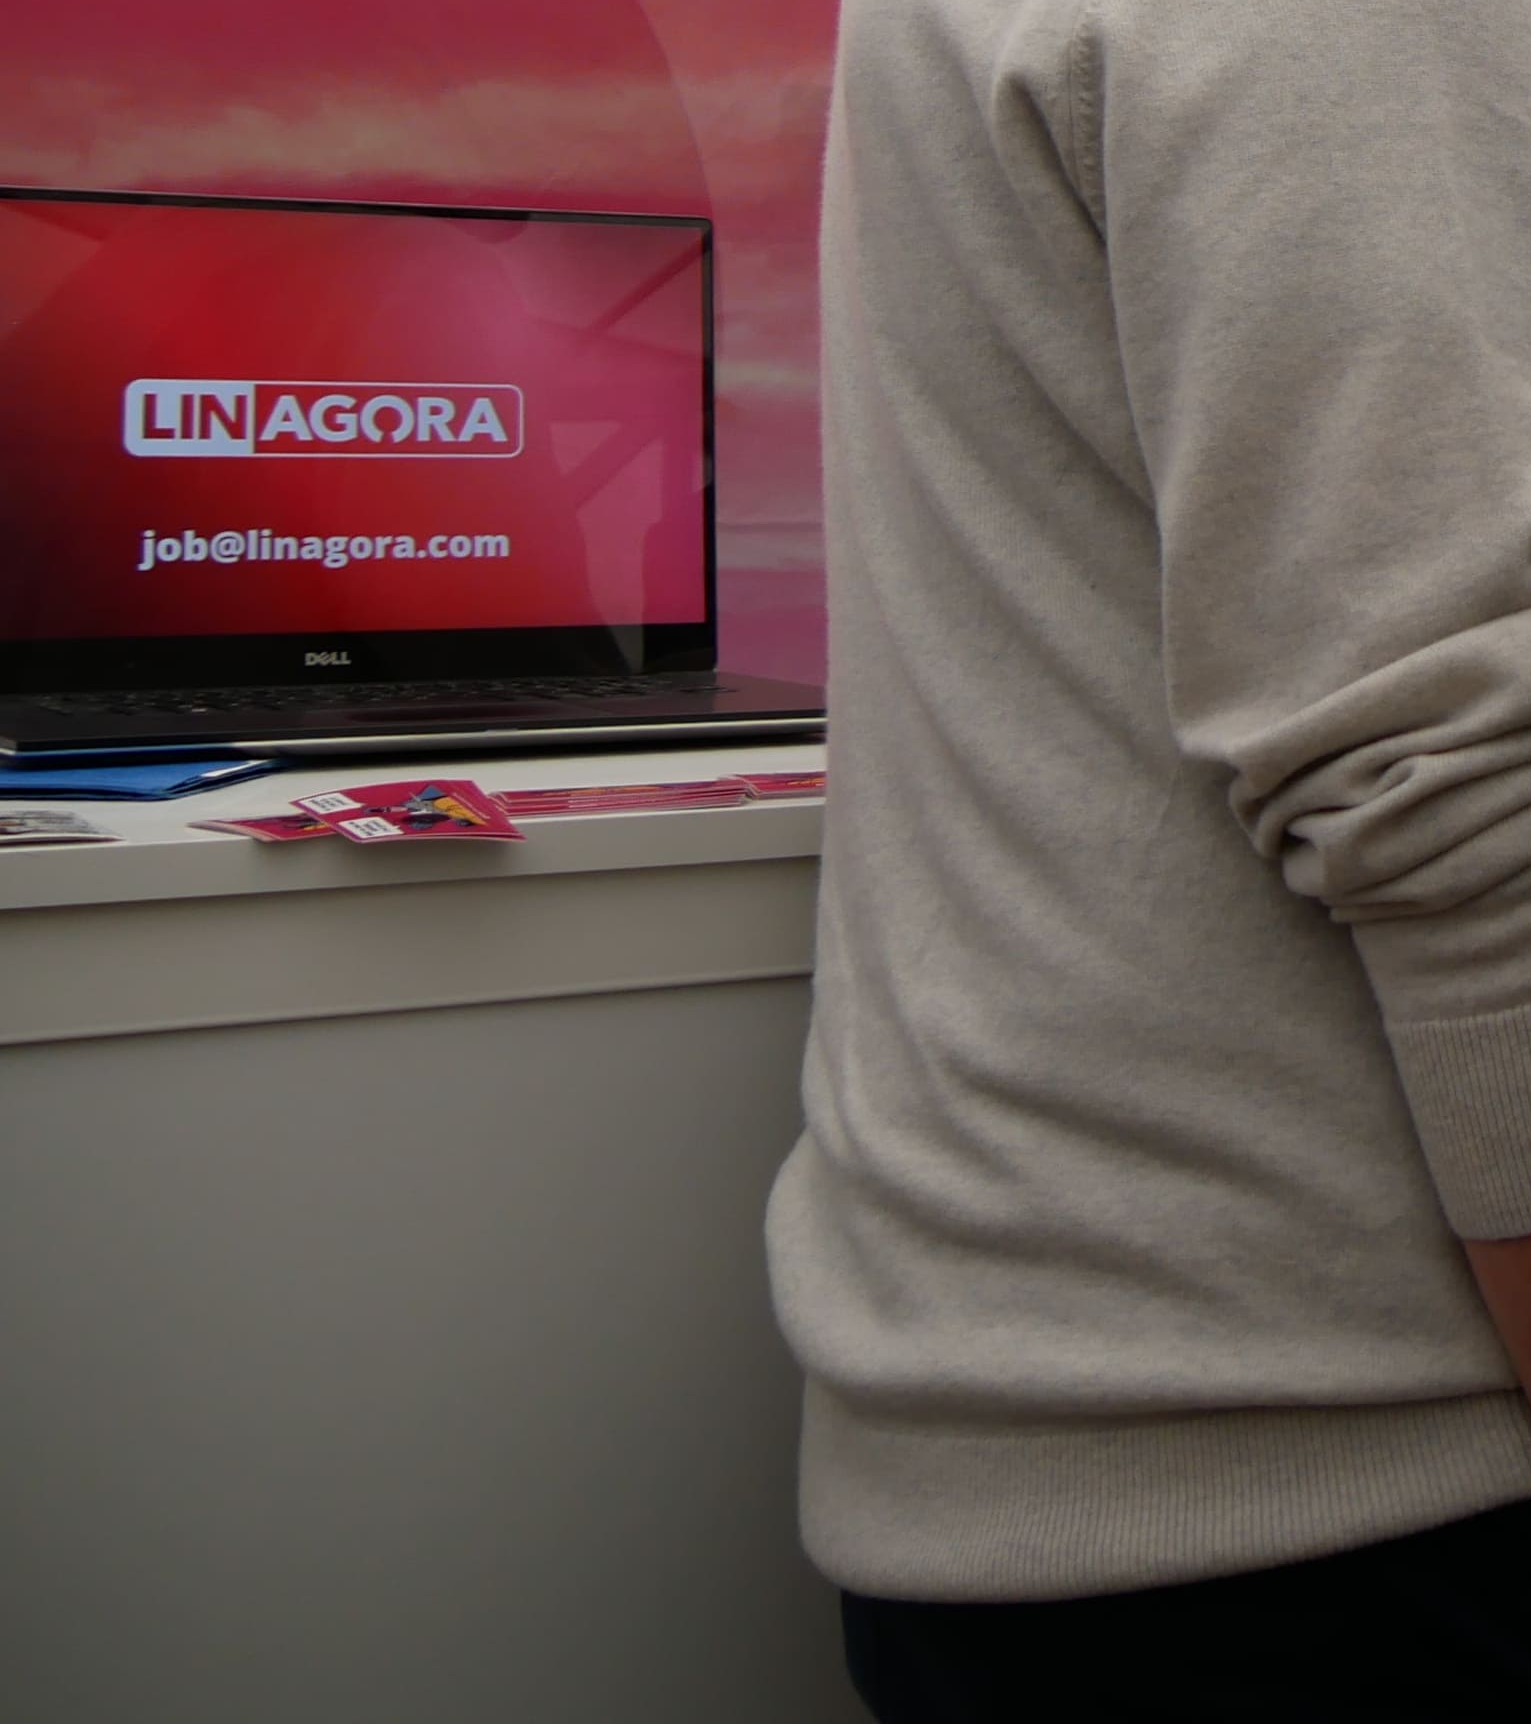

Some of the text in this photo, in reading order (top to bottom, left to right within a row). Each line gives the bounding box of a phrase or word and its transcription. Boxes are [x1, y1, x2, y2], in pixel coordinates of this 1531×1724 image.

[140, 391, 509, 444] LINAGORA
[138, 529, 511, 572] job@linagora.com
[304, 650, 352, 666] DELL
